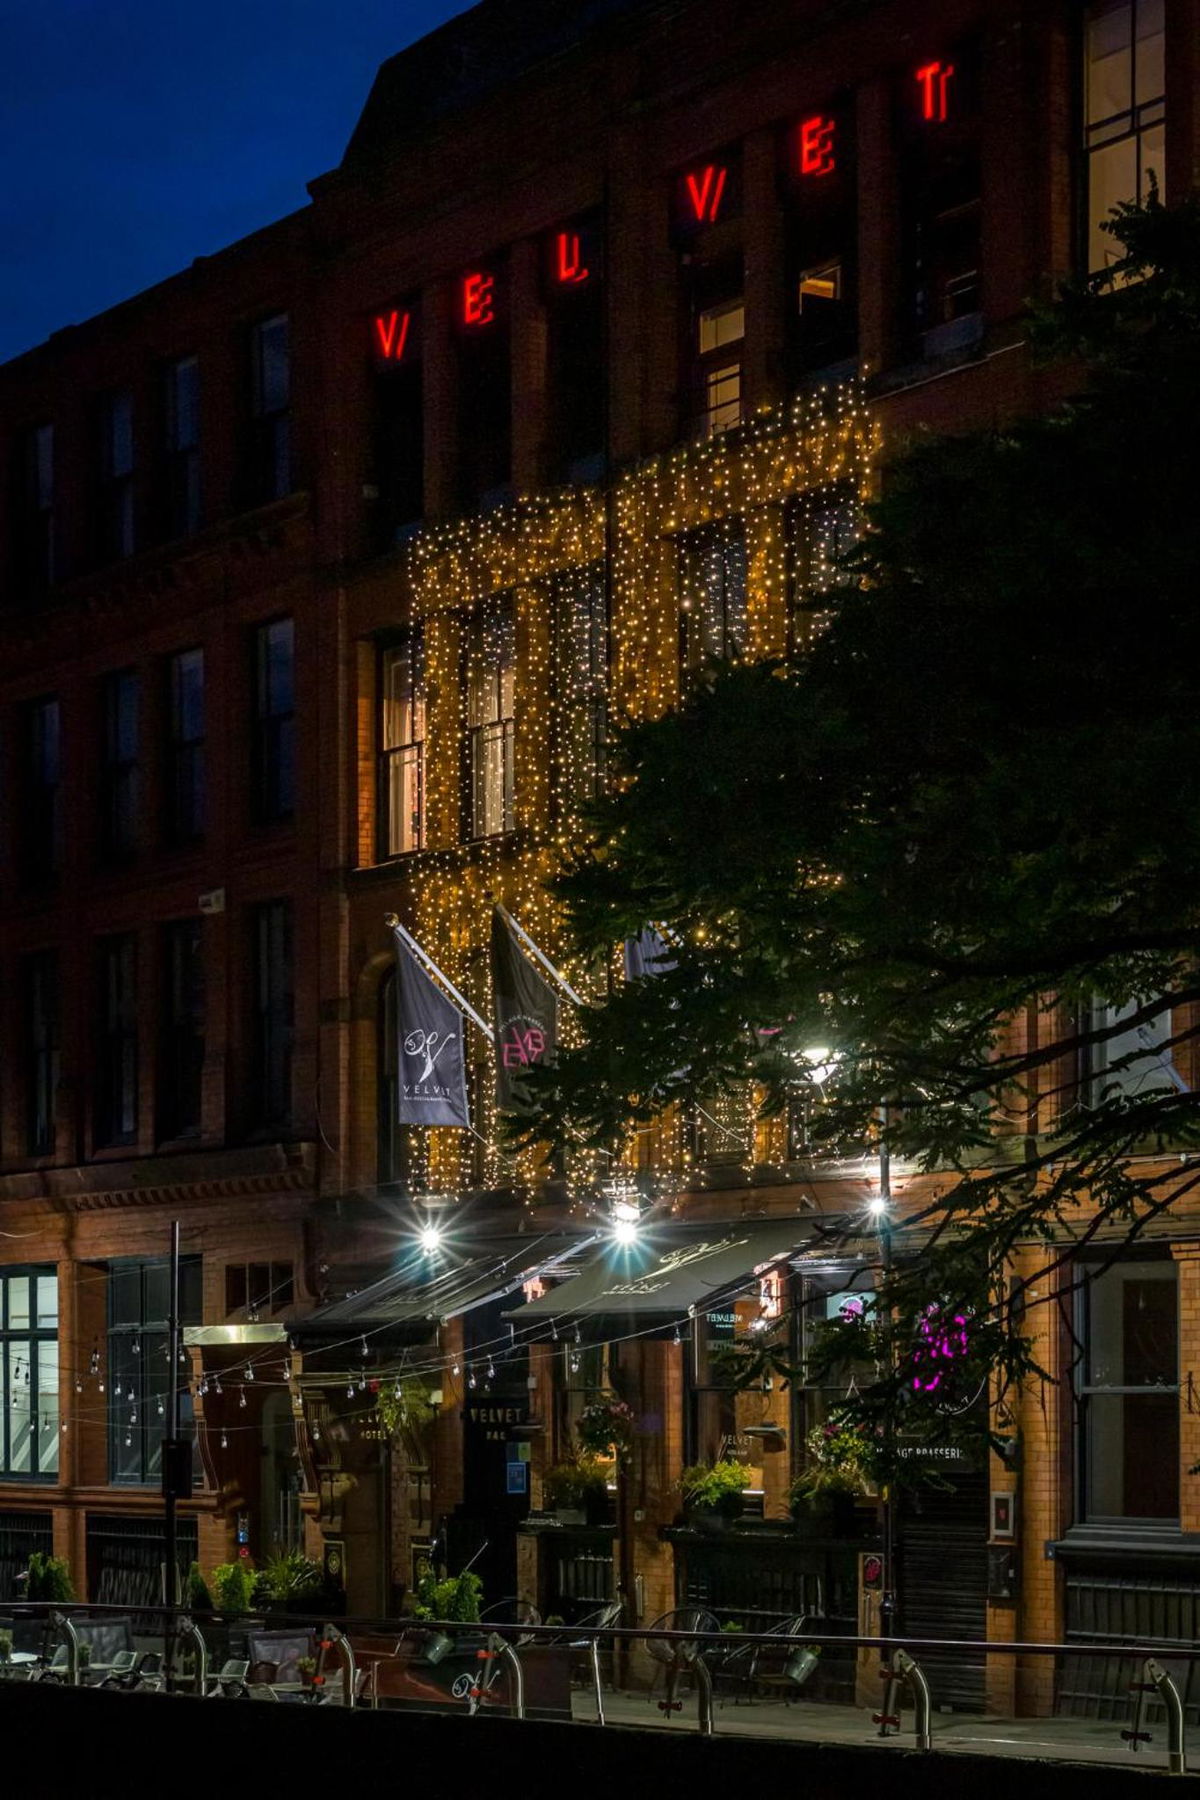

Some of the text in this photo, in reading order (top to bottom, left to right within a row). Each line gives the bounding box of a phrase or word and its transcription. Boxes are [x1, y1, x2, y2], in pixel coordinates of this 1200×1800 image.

[375, 61, 954, 359] VELVET
[470, 1408, 522, 1423] VELVET
[916, 1447, 964, 1459] BRASSERI
